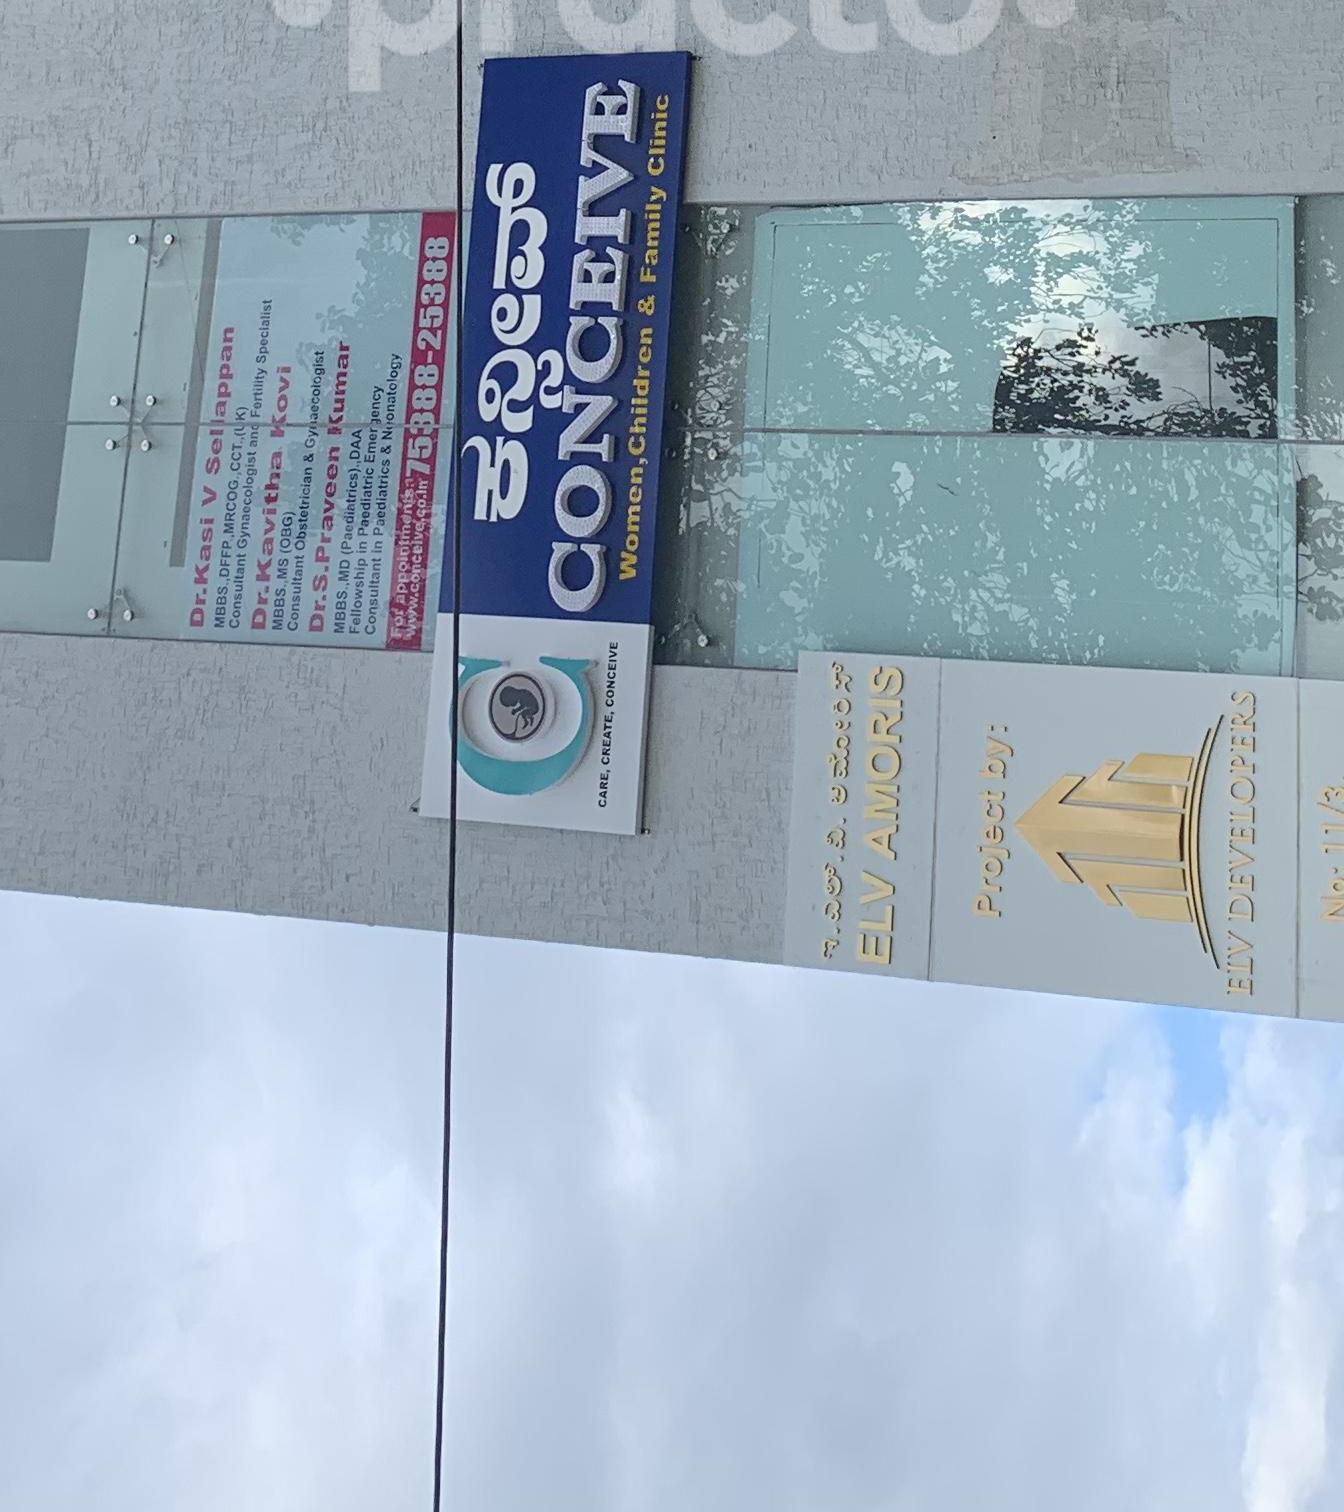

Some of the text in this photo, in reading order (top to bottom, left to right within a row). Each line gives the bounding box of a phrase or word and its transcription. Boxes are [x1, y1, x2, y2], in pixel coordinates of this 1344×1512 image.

[189, 326, 235, 628] Dr.Kasi V Sellappan
[228, 299, 273, 629] Consultant Gynaecologist and Fertility Specialist
[405, 237, 451, 478] 75388-25388
[460, 161, 565, 523] ಕನ್ಸೀವ್
[547, 78, 642, 612] CONCEIVE
[618, 93, 670, 581] Women,Children & Family Clinic
[250, 365, 292, 631] Dr.Kavitha Kovi
[279, 511, 297, 554] (OBG)
[286, 350, 326, 632] Consultant Obstetrician & Gynaecologist
[308, 339, 351, 633] Dr.S.Praveen Kumar
[348, 385, 385, 635] Fellowship in Paediatric Emergency
[364, 353, 402, 636] Consultant in Paediatrics & Neonatology
[390, 608, 404, 638] For
[597, 641, 619, 808] CARE, CREATE, CONCEIVE
[855, 665, 904, 965] ELV AMORIS
[972, 724, 1014, 918] Project by:
[1225, 690, 1256, 996] ELV DEVELOPERS
